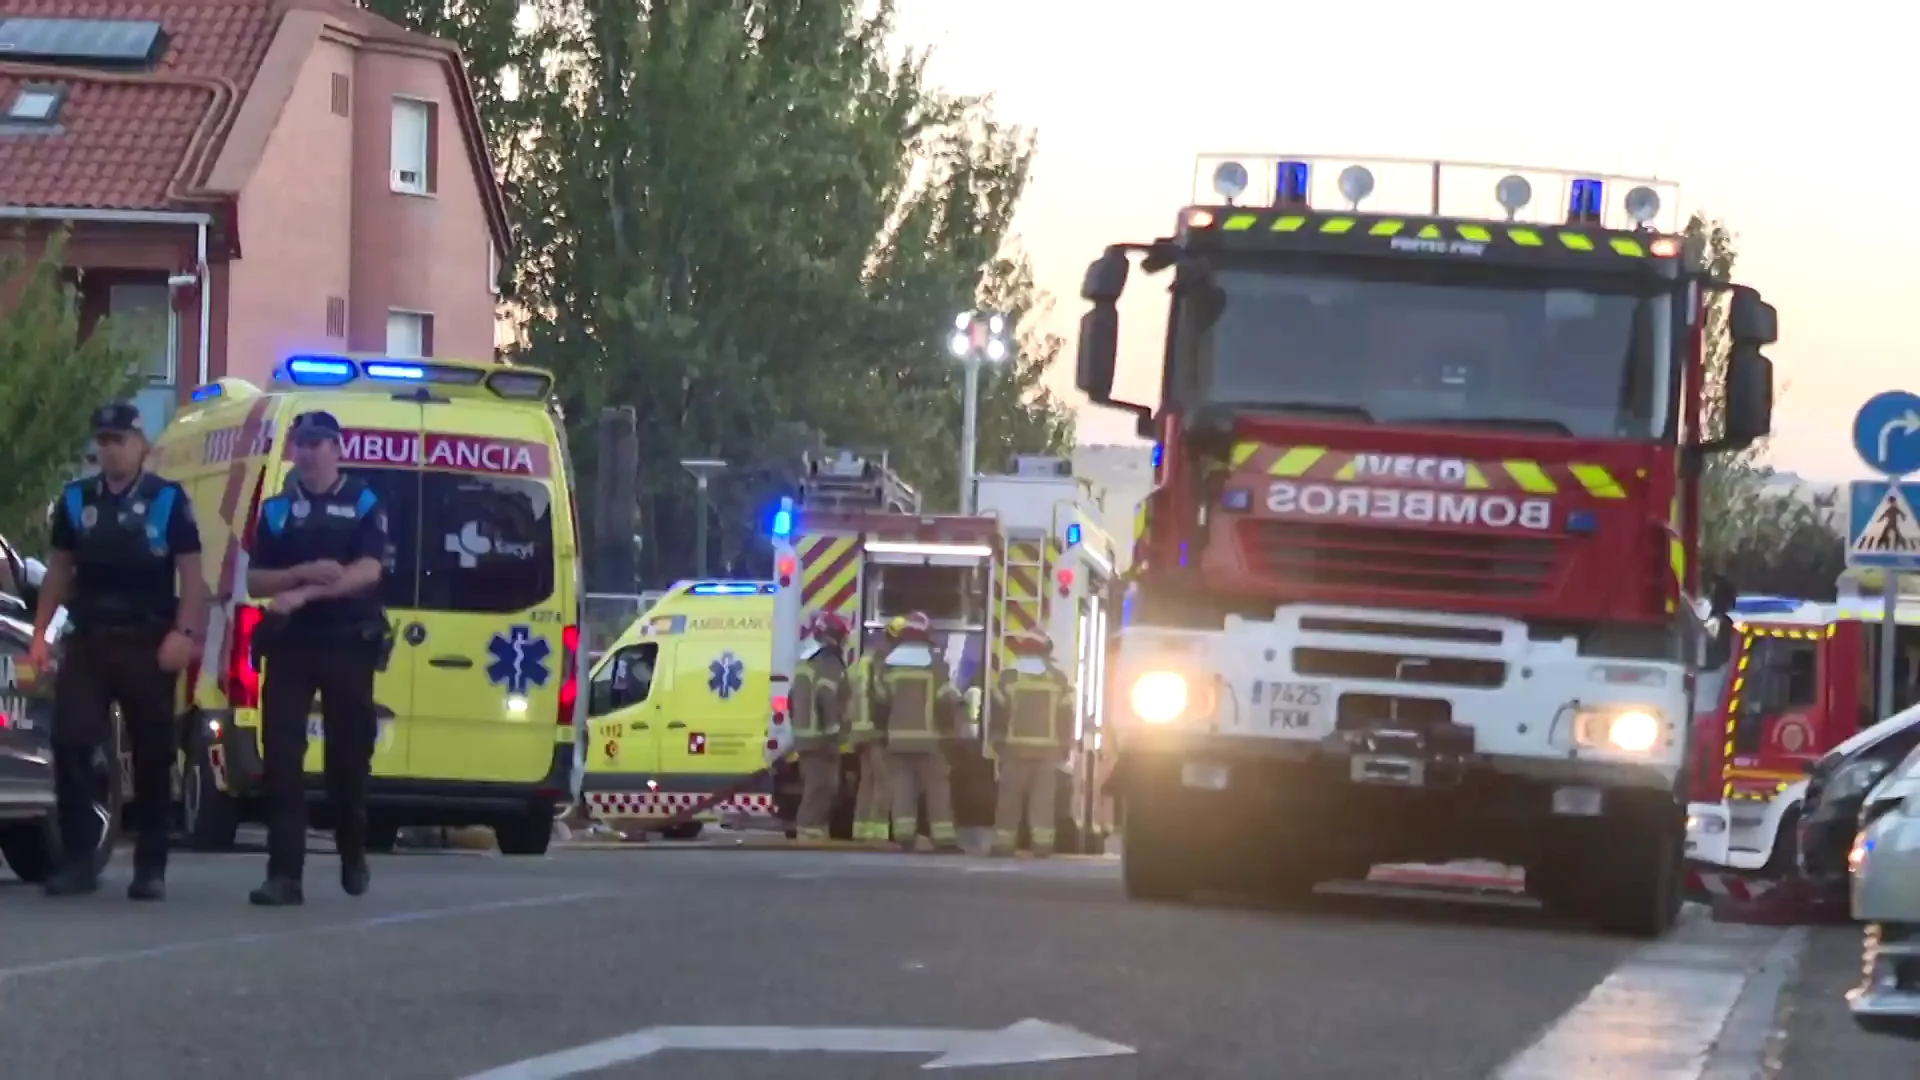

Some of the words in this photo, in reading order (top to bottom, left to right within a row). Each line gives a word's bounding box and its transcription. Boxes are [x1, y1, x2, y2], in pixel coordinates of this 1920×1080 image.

[339, 432, 534, 473] MBULANCIA
[1353, 454, 1466, 480] IVECO
[1270, 682, 1322, 706] 7425
